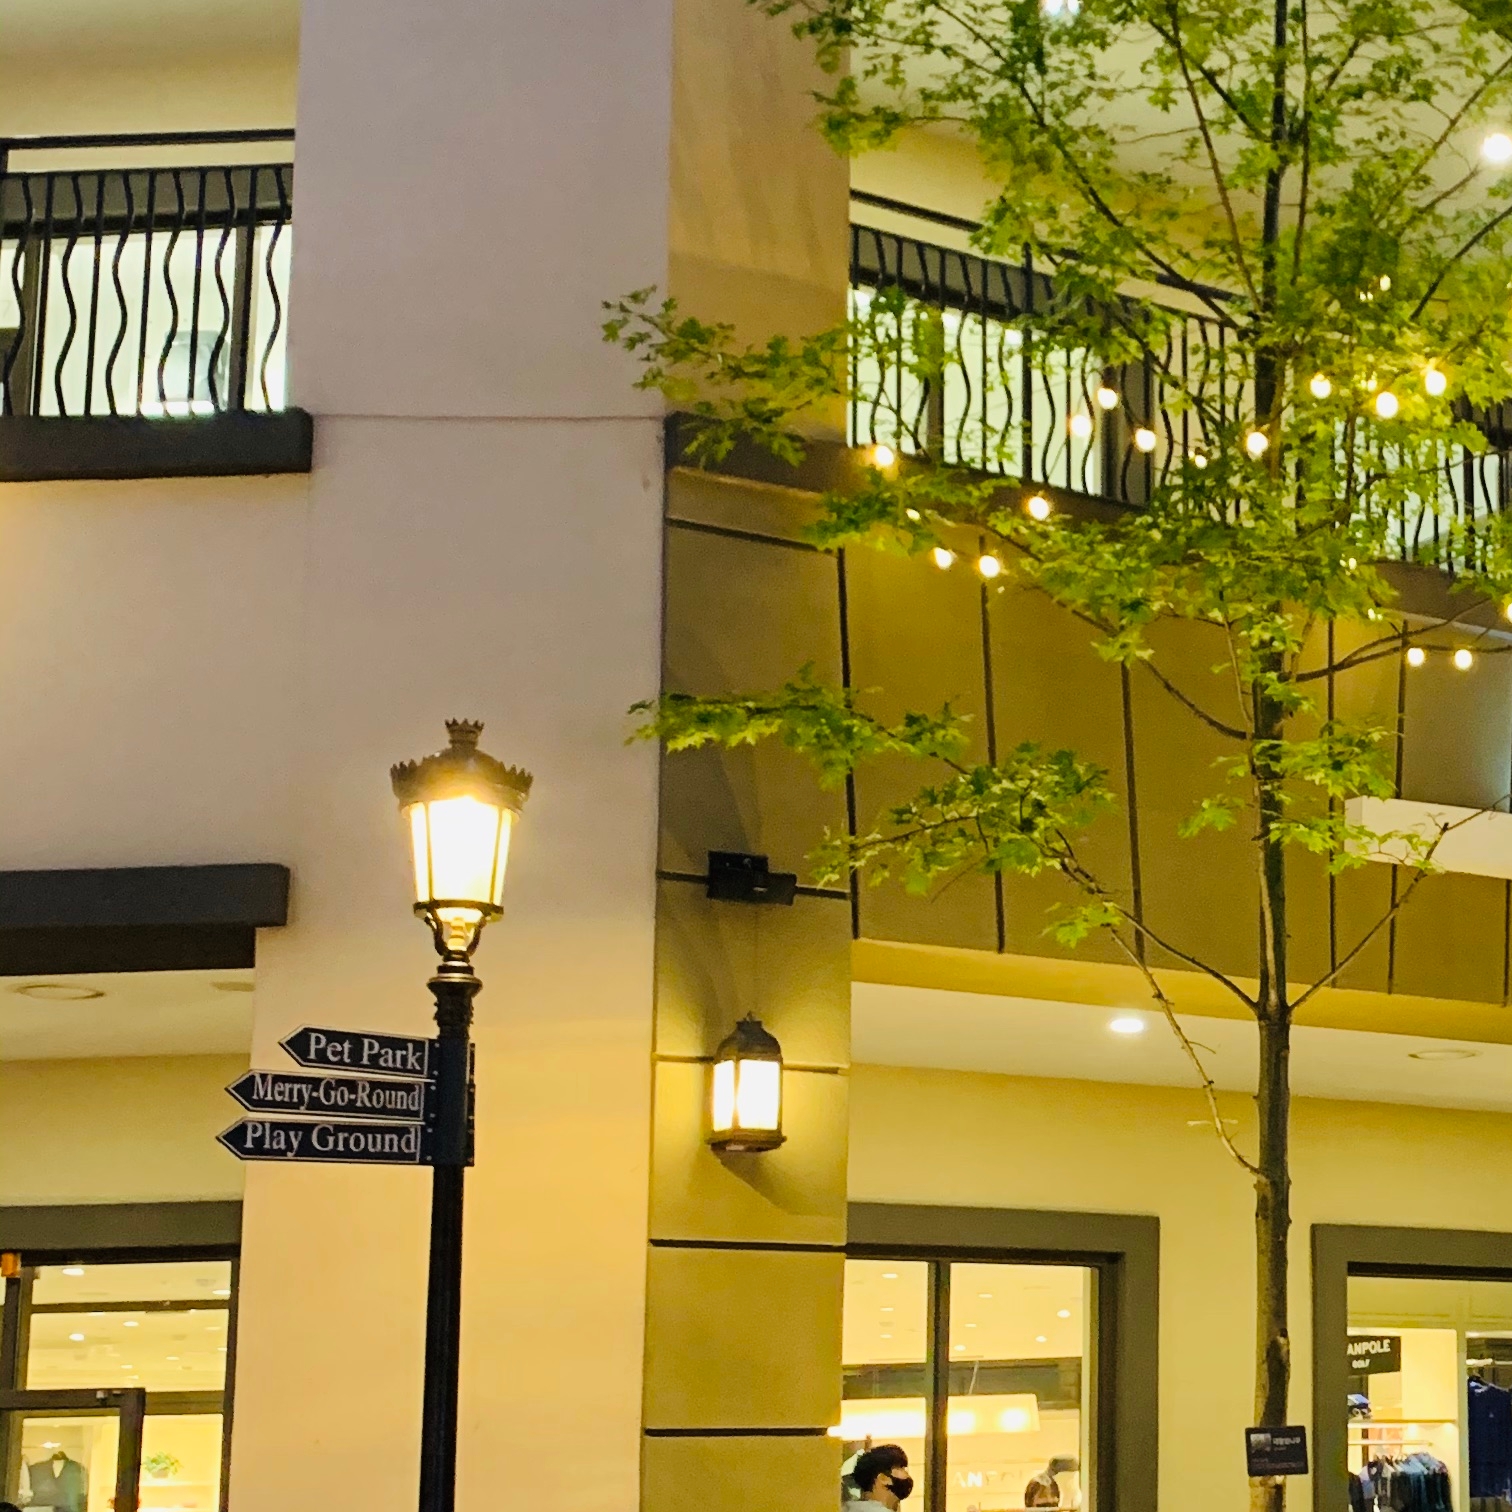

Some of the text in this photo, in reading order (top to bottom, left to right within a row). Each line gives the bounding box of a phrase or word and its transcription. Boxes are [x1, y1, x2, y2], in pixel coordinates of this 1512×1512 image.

[307, 1032, 422, 1071] Pet Park
[252, 1073, 421, 1111] Merry-Go-Round
[243, 1122, 416, 1157] Play Ground
[1347, 1339, 1391, 1356] ANPOLE
